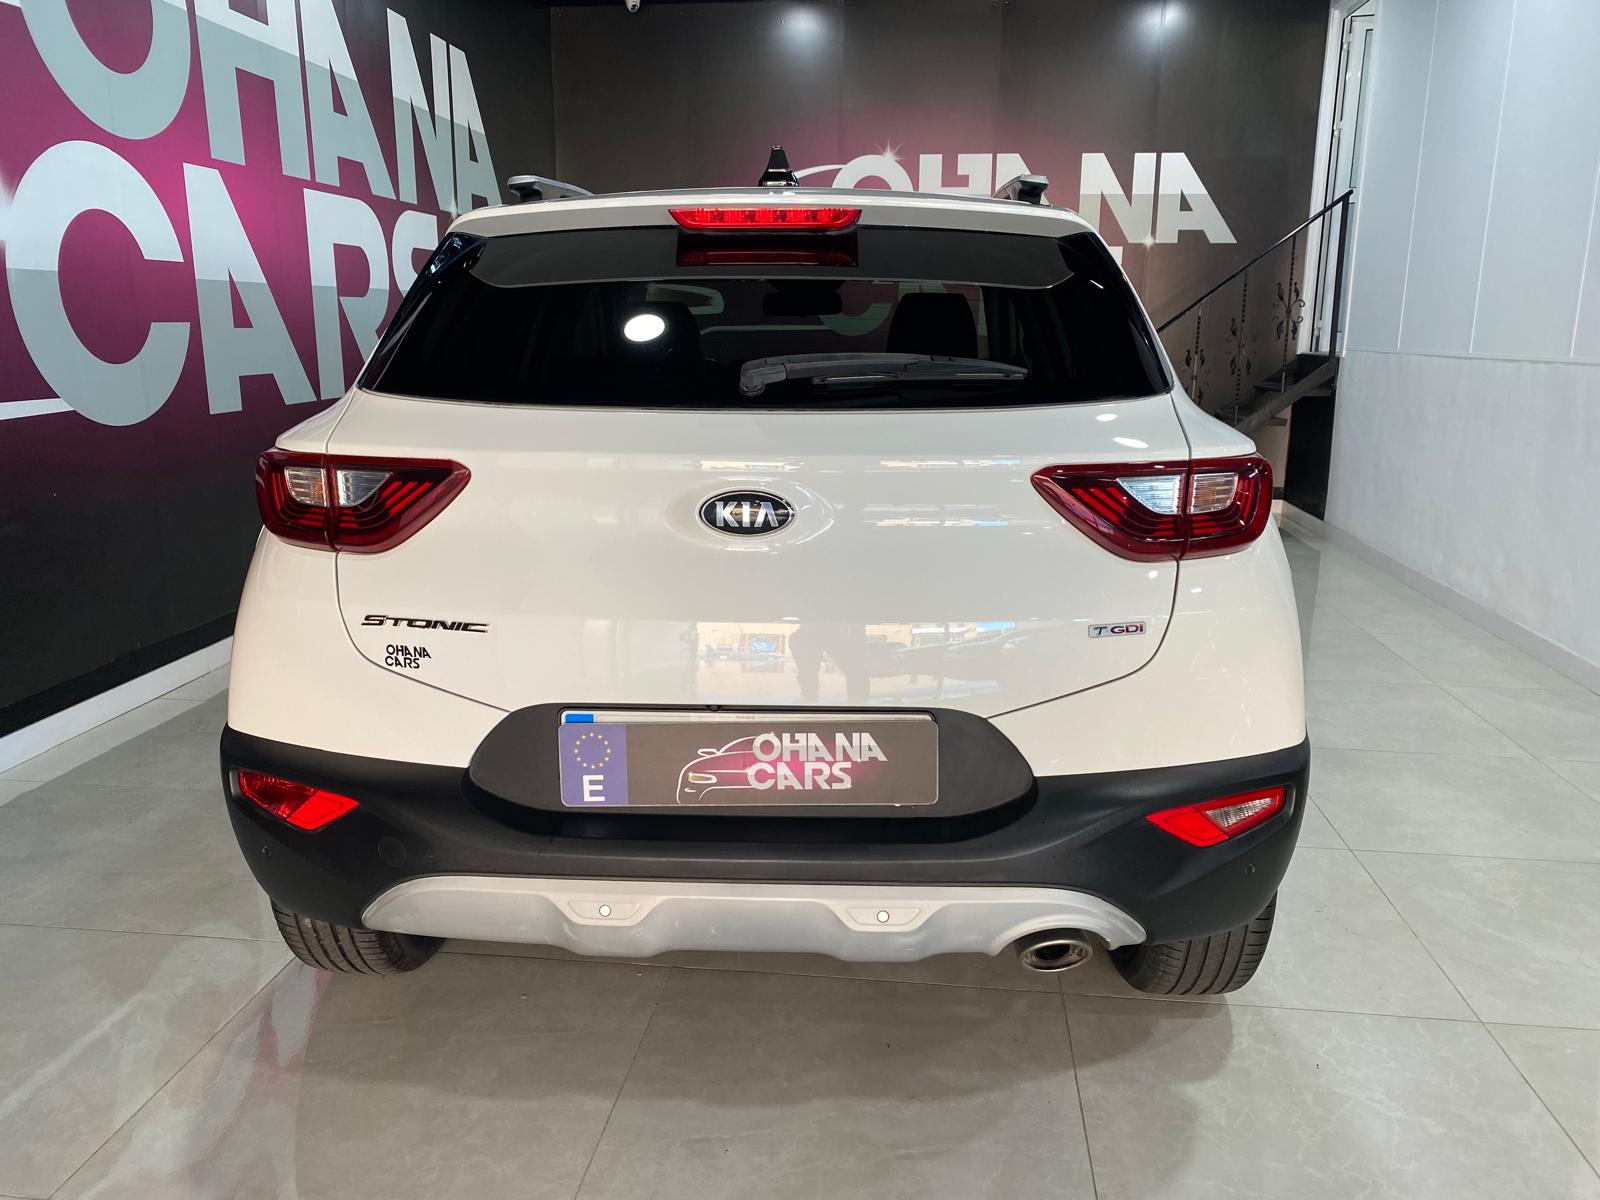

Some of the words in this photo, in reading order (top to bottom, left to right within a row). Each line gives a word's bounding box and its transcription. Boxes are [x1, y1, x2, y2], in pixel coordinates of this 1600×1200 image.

[715, 501, 779, 527] KIA
[361, 614, 488, 633] STONIC
[1093, 626, 1107, 636] T
[384, 655, 420, 669] CARS
[385, 644, 432, 659] OHANA
[752, 732, 888, 762] OHANA
[747, 761, 852, 790] CARS
[582, 774, 606, 802] E
